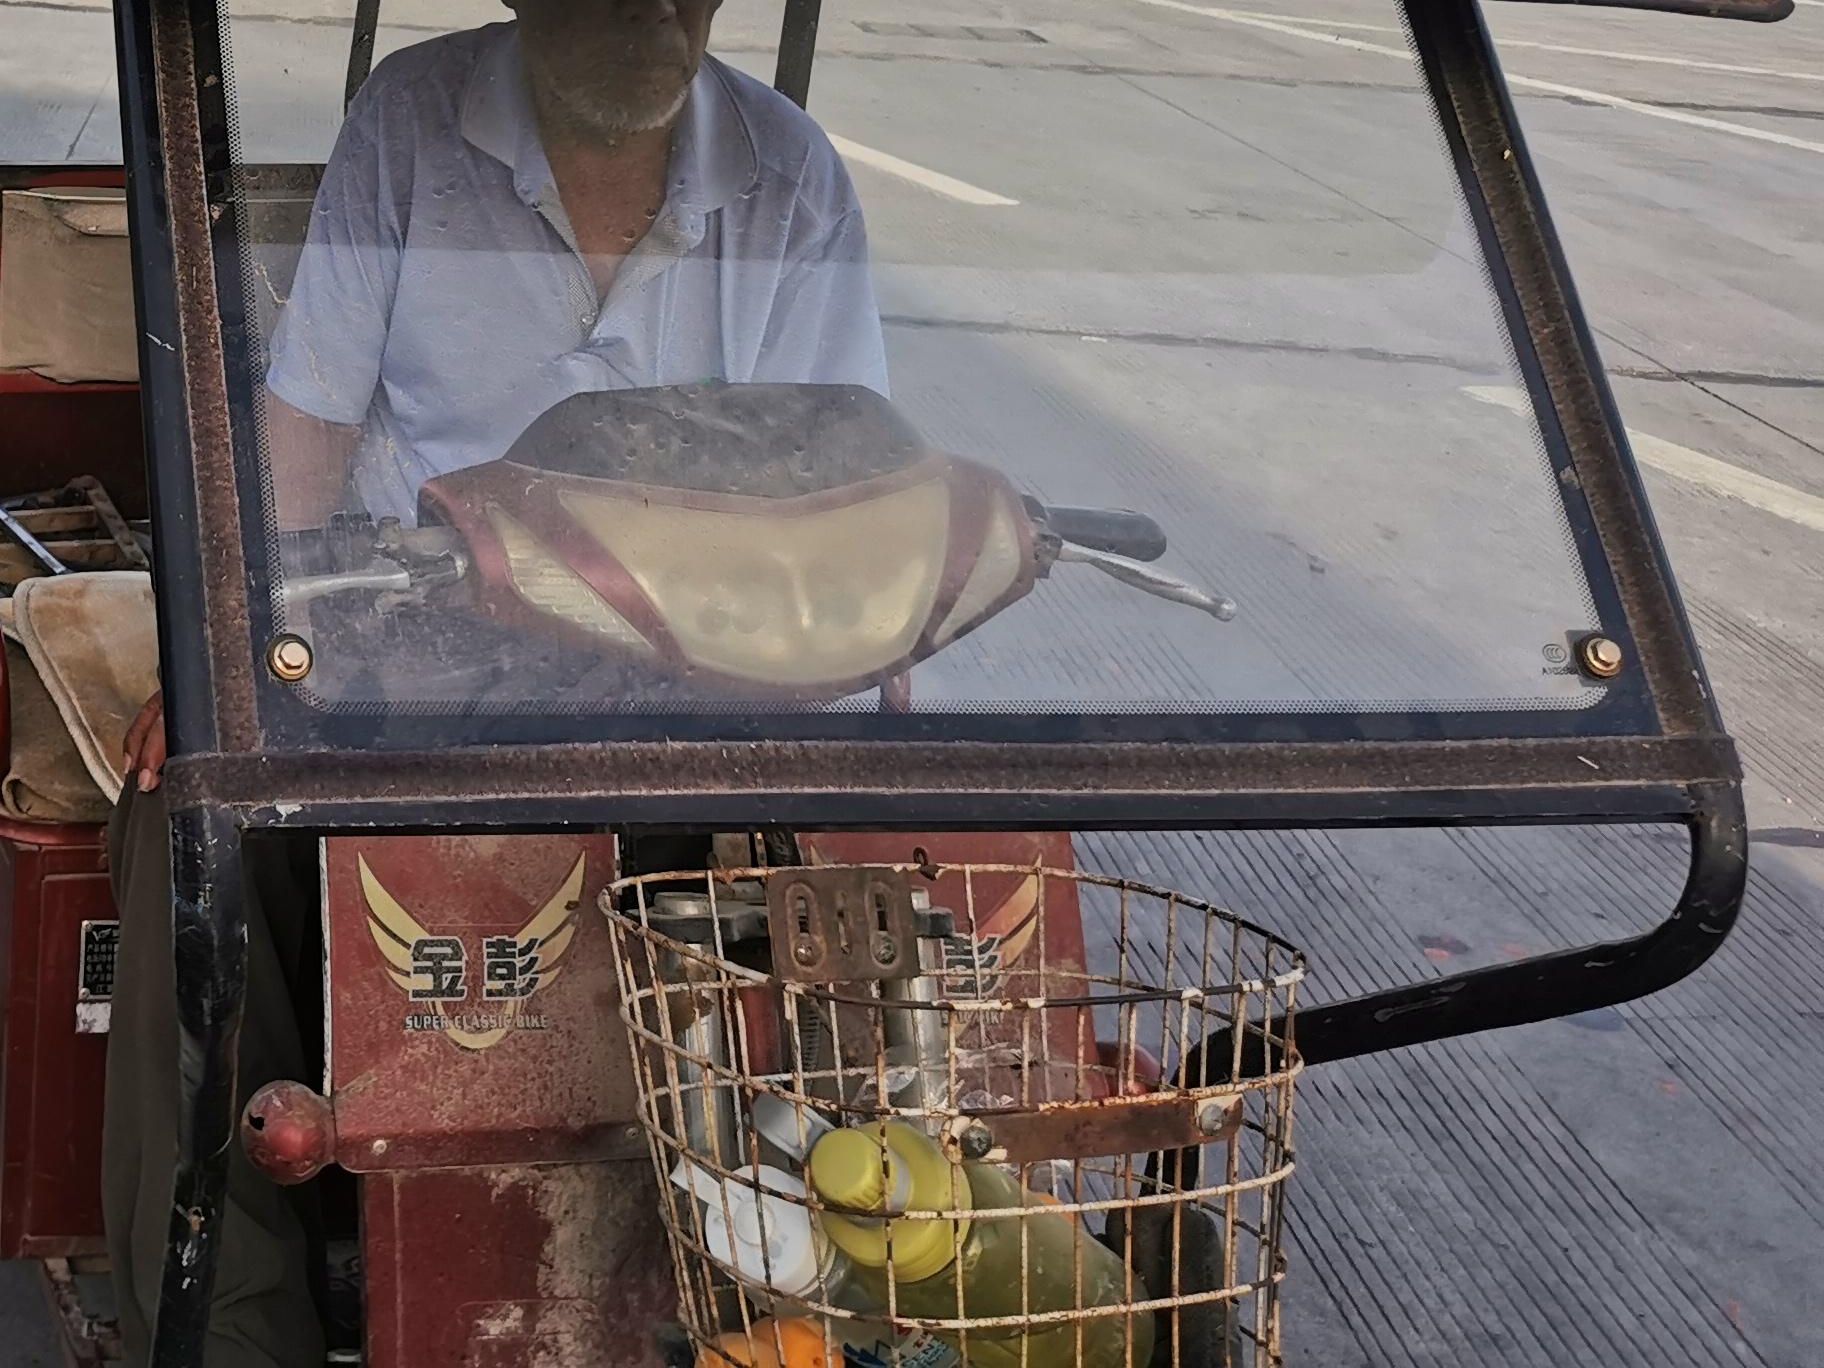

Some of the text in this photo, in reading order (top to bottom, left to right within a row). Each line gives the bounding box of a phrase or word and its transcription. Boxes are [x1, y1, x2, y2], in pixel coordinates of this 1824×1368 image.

[409, 936, 542, 1001] 金彭
[405, 1014, 549, 1030] SUPER CLASSIC BIKE
